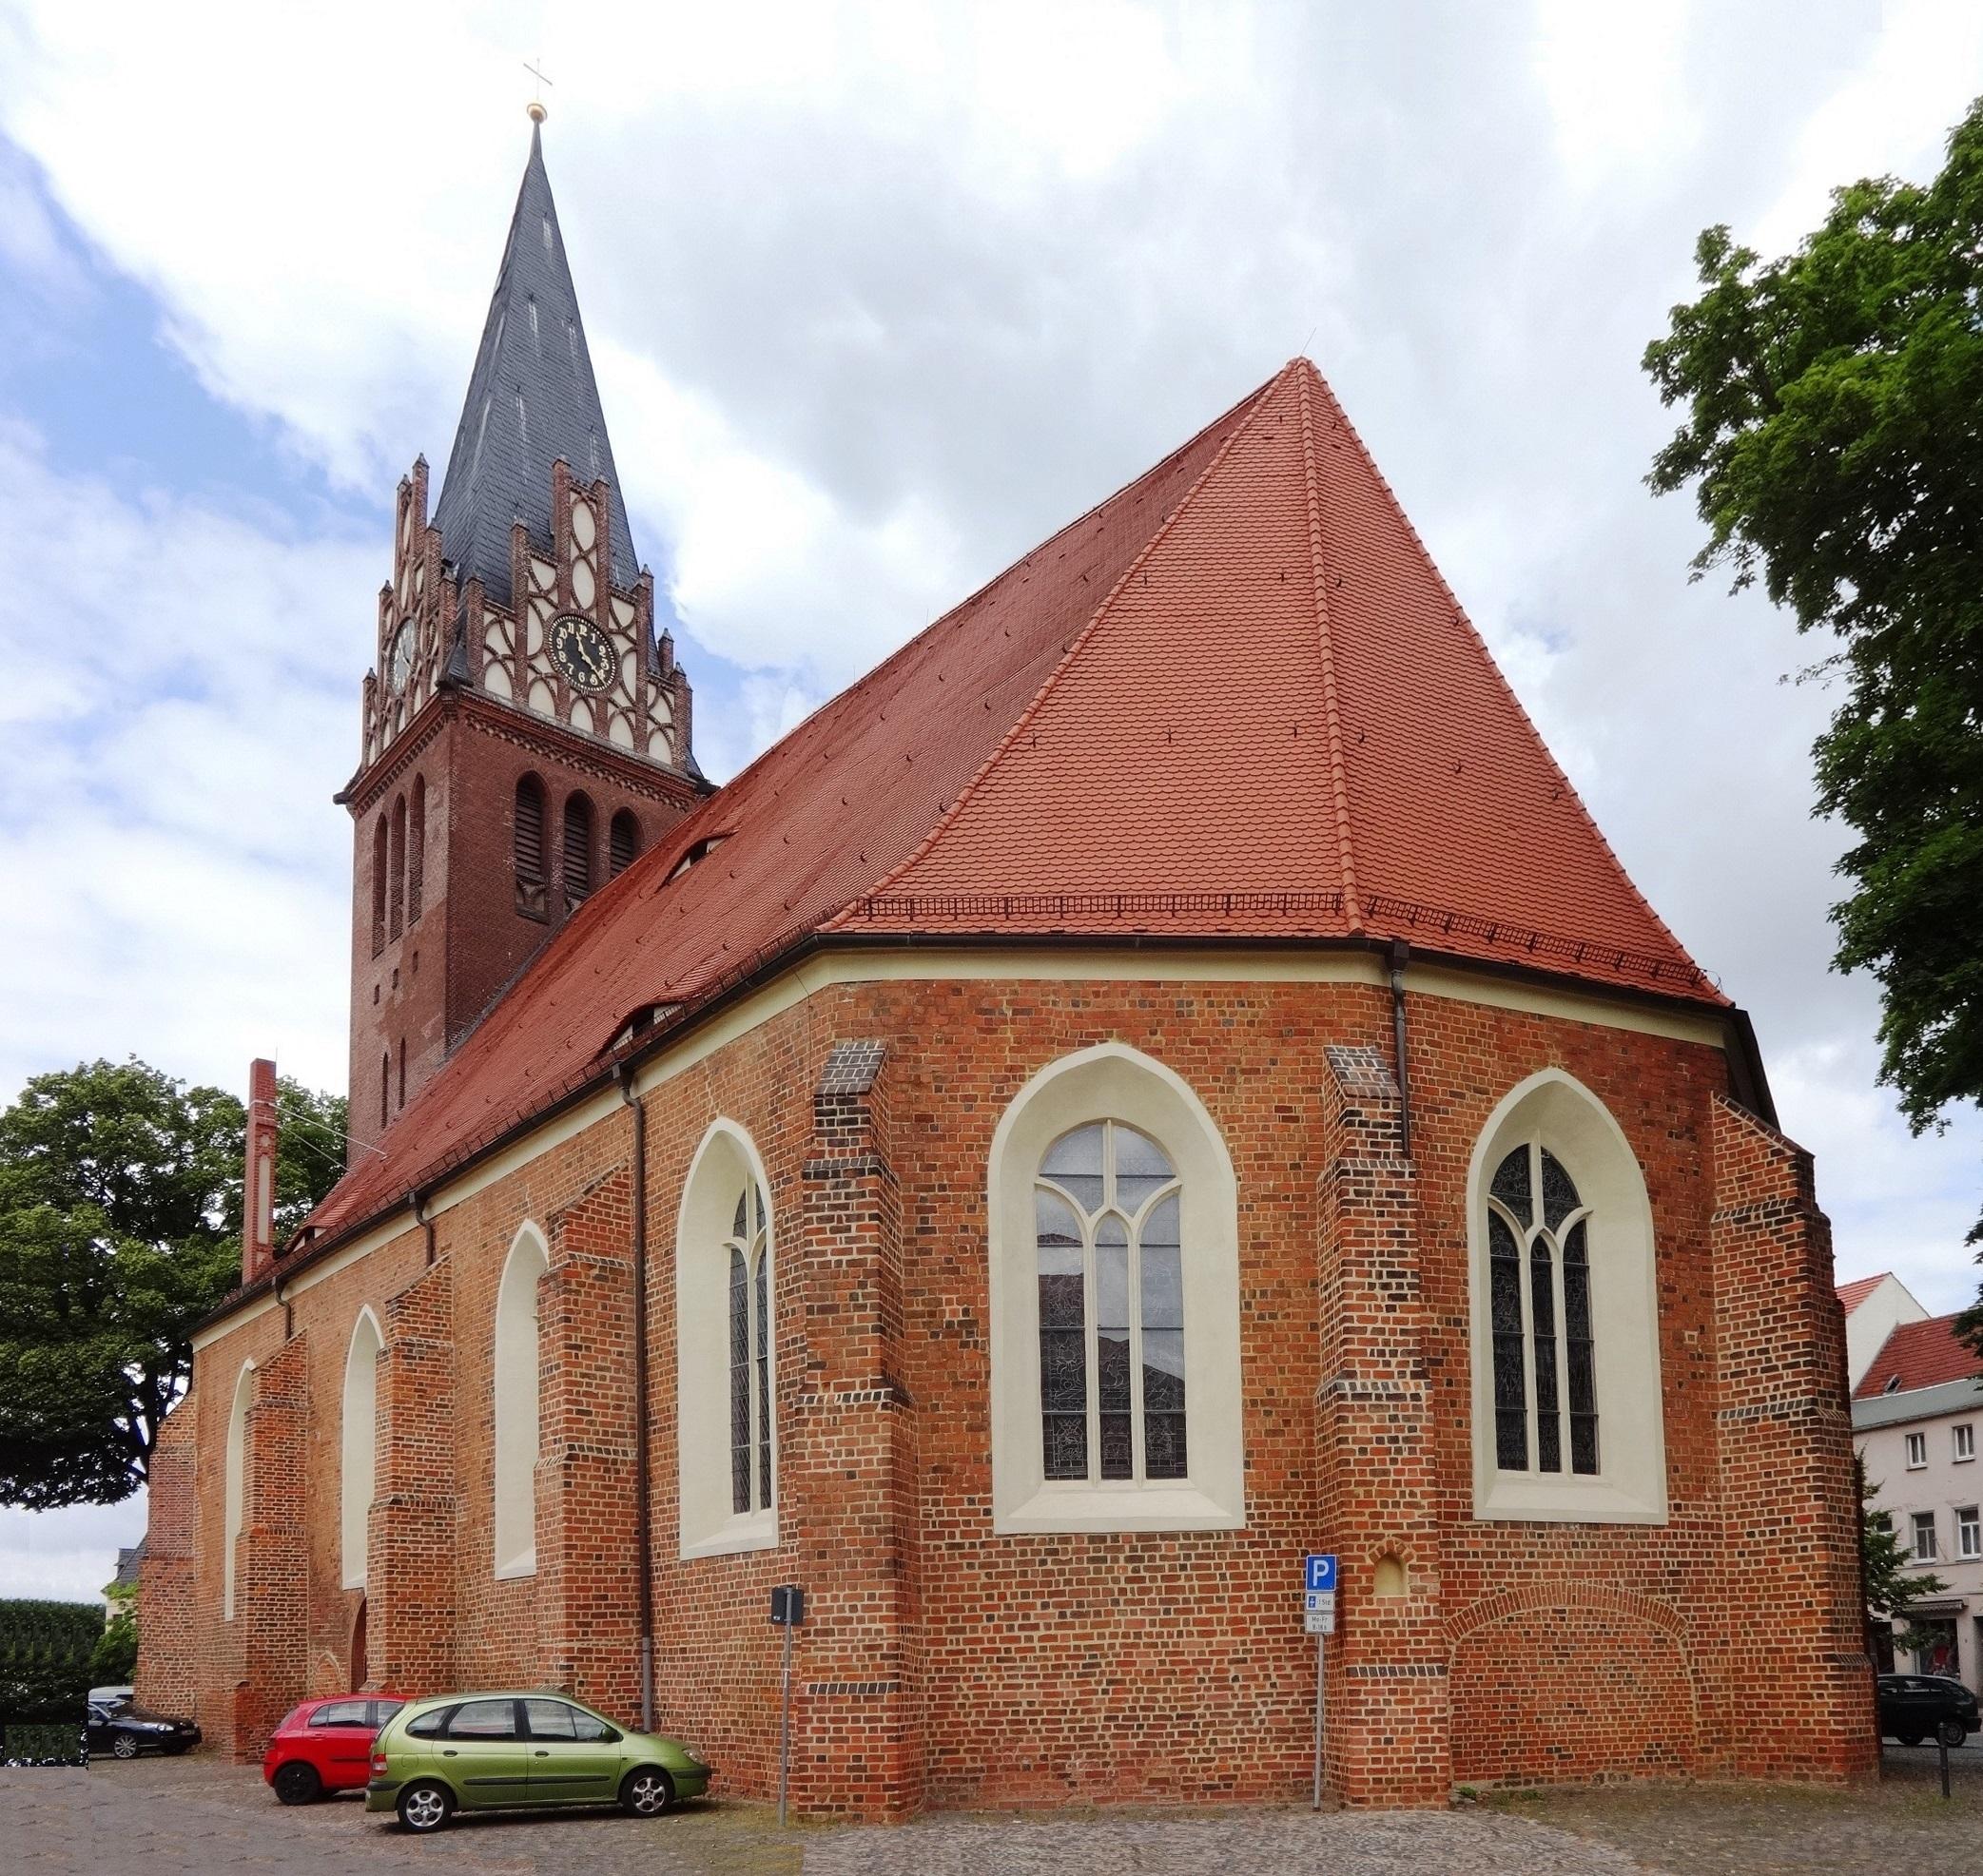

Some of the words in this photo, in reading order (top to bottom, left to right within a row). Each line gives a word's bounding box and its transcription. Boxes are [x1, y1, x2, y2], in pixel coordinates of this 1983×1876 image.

[556, 638, 563, 649] 9
[590, 633, 596, 644] 1
[558, 651, 567, 663] 8
[598, 646, 606, 657] 2
[567, 663, 574, 675] 7
[600, 659, 610, 670] 3
[578, 672, 586, 683] 6
[597, 668, 606, 679] 4
[590, 674, 598, 686] 5
[1312, 1559, 1330, 1587] P
